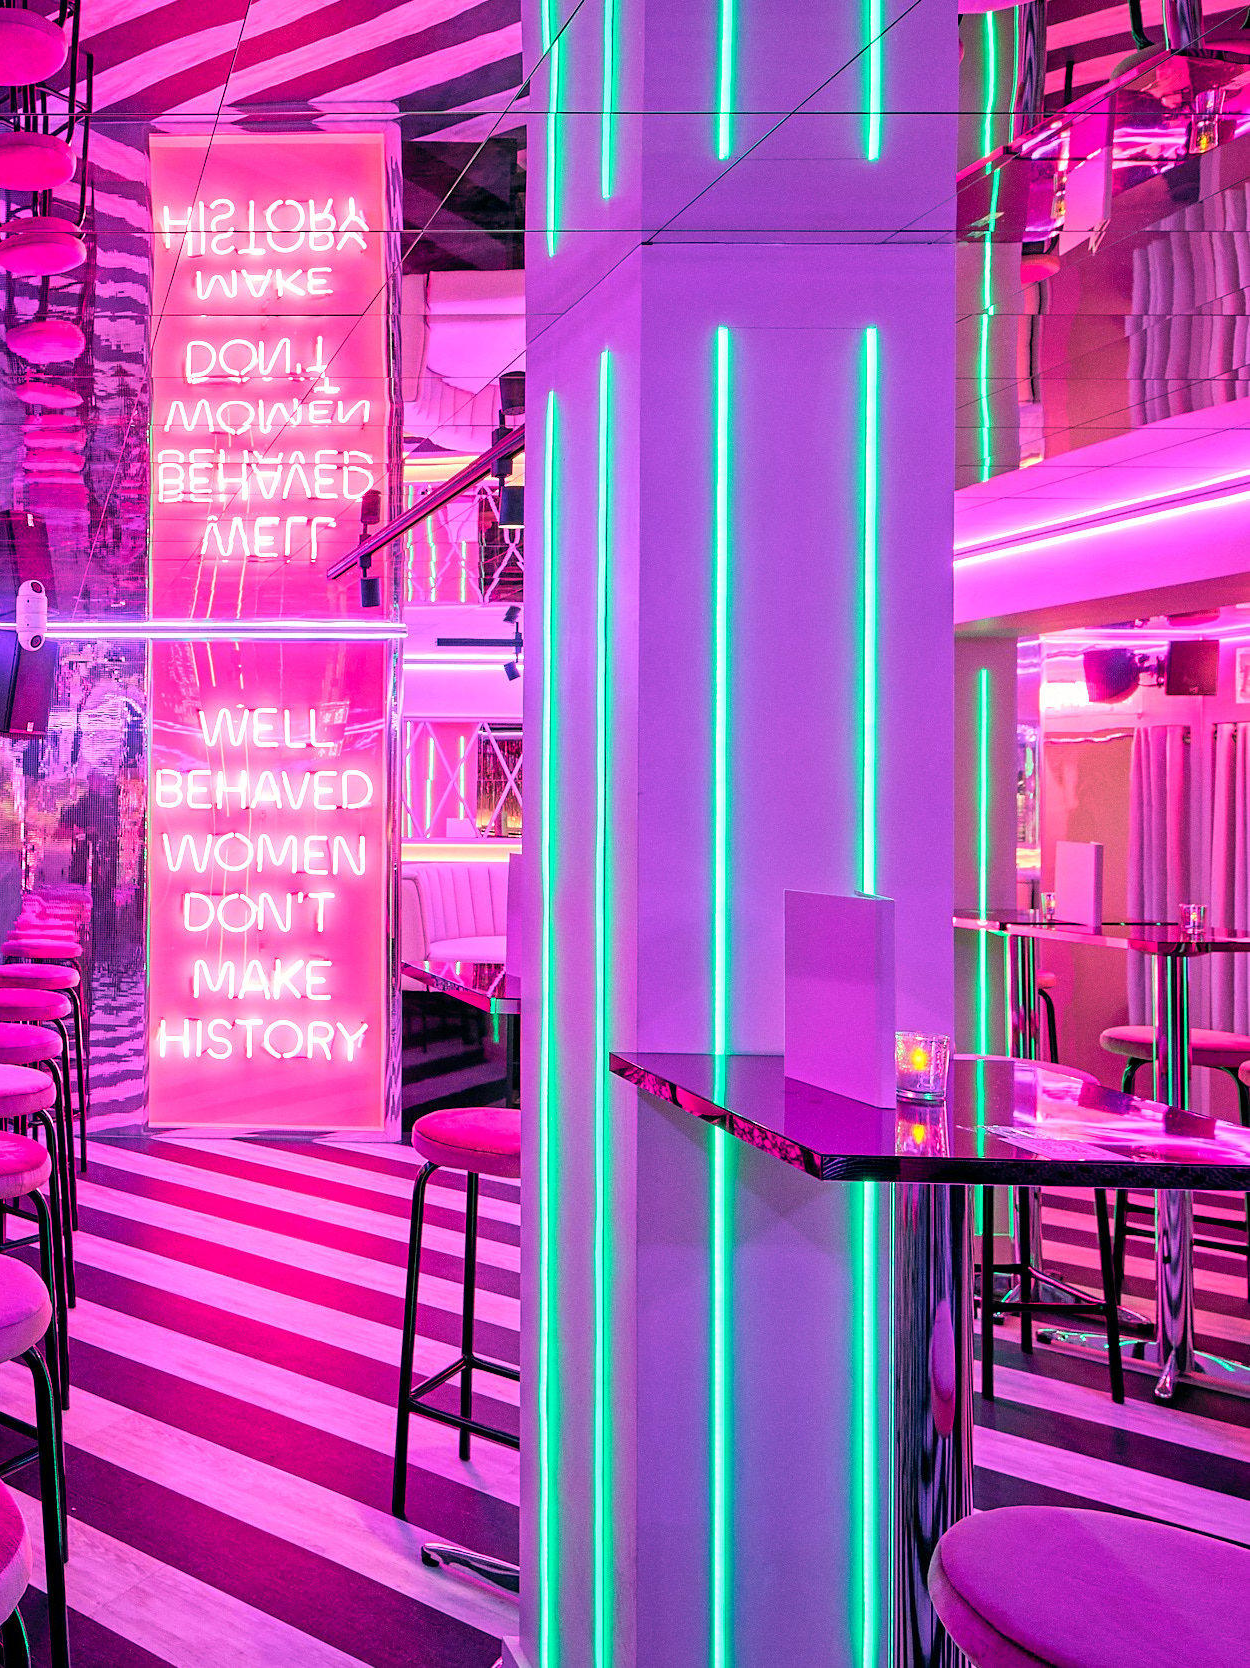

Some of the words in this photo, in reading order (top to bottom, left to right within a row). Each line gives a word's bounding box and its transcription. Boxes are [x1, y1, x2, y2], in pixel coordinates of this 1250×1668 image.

[198, 706, 334, 748] WELL
[155, 769, 374, 811] BEHAVED
[162, 832, 366, 876] WOMEN
[183, 892, 336, 933] DON'T
[192, 959, 333, 1001] MAKE
[158, 1018, 369, 1062] HISTORY
